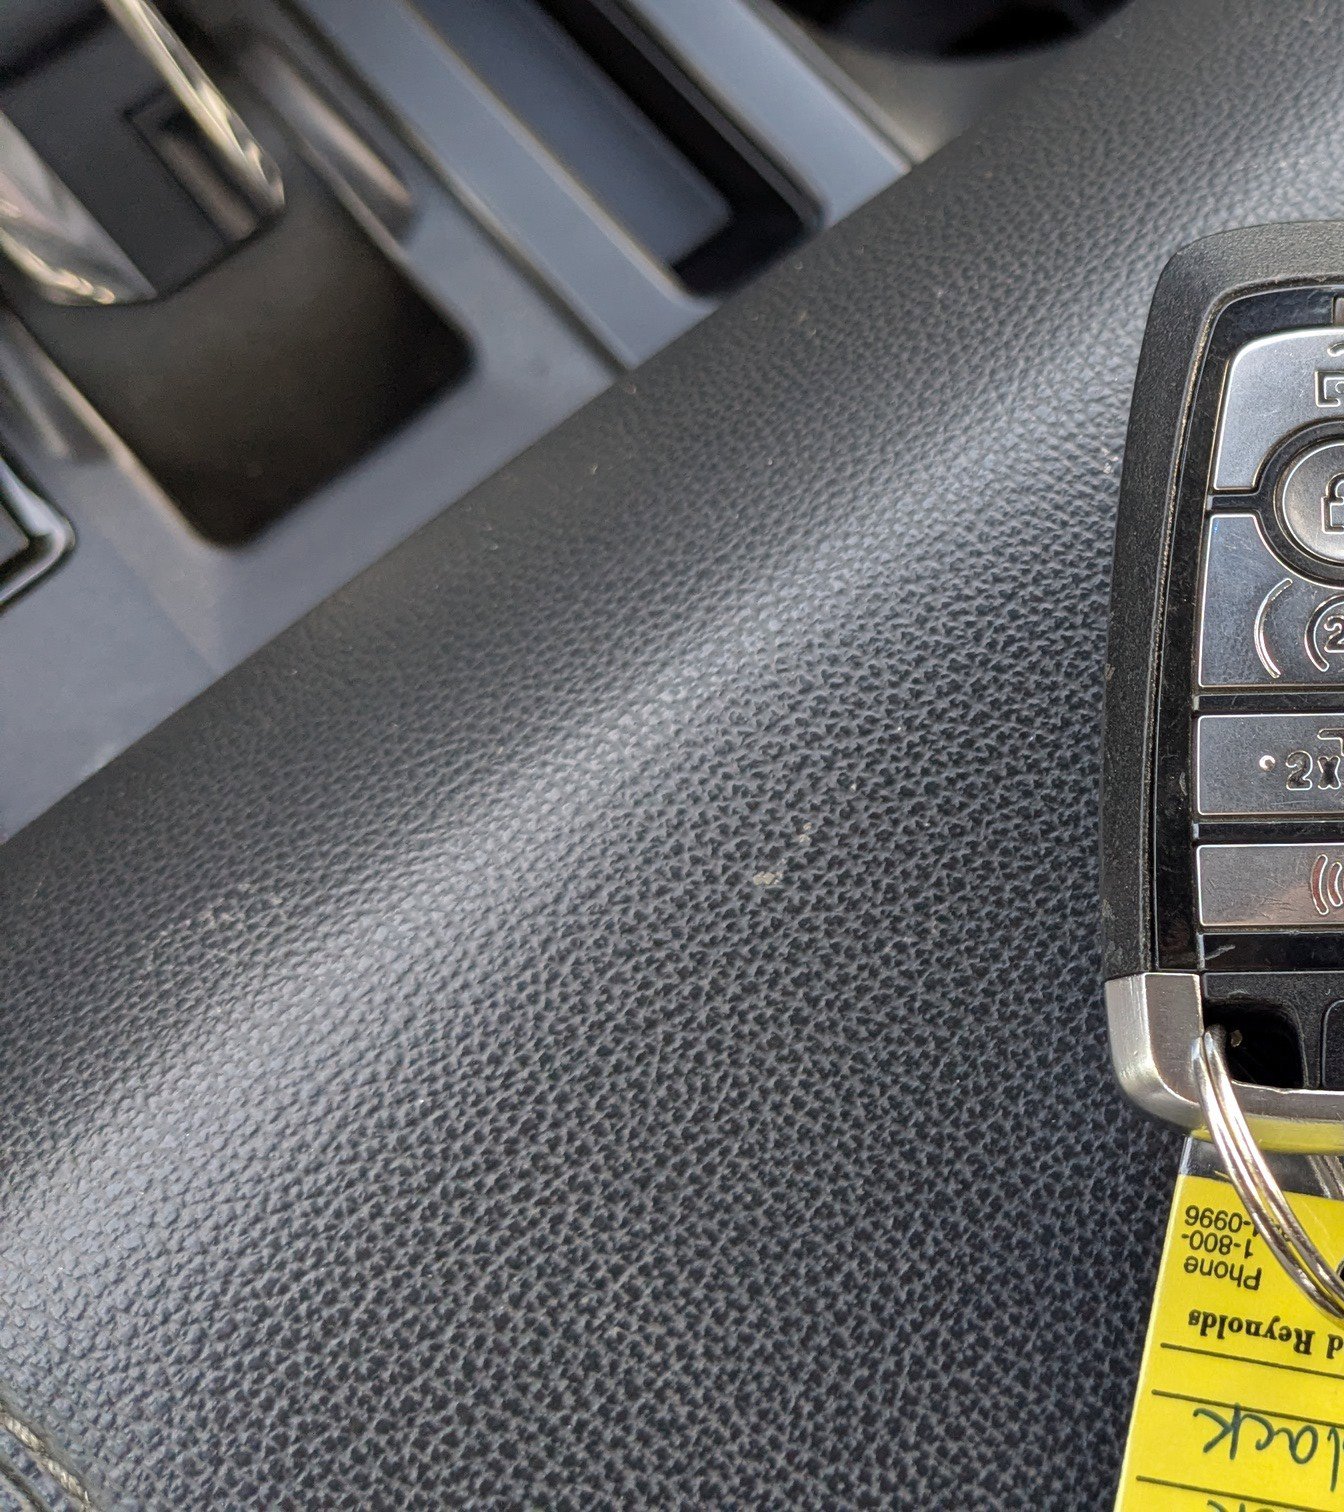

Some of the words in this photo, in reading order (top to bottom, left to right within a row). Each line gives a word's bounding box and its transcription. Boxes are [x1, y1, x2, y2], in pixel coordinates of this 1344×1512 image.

[1285, 750, 1341, 791] 2x
[1181, 1229, 1253, 1259] 1-800-
[1183, 1255, 1262, 1291] Phone
[1187, 1308, 1316, 1356] Reynolds
